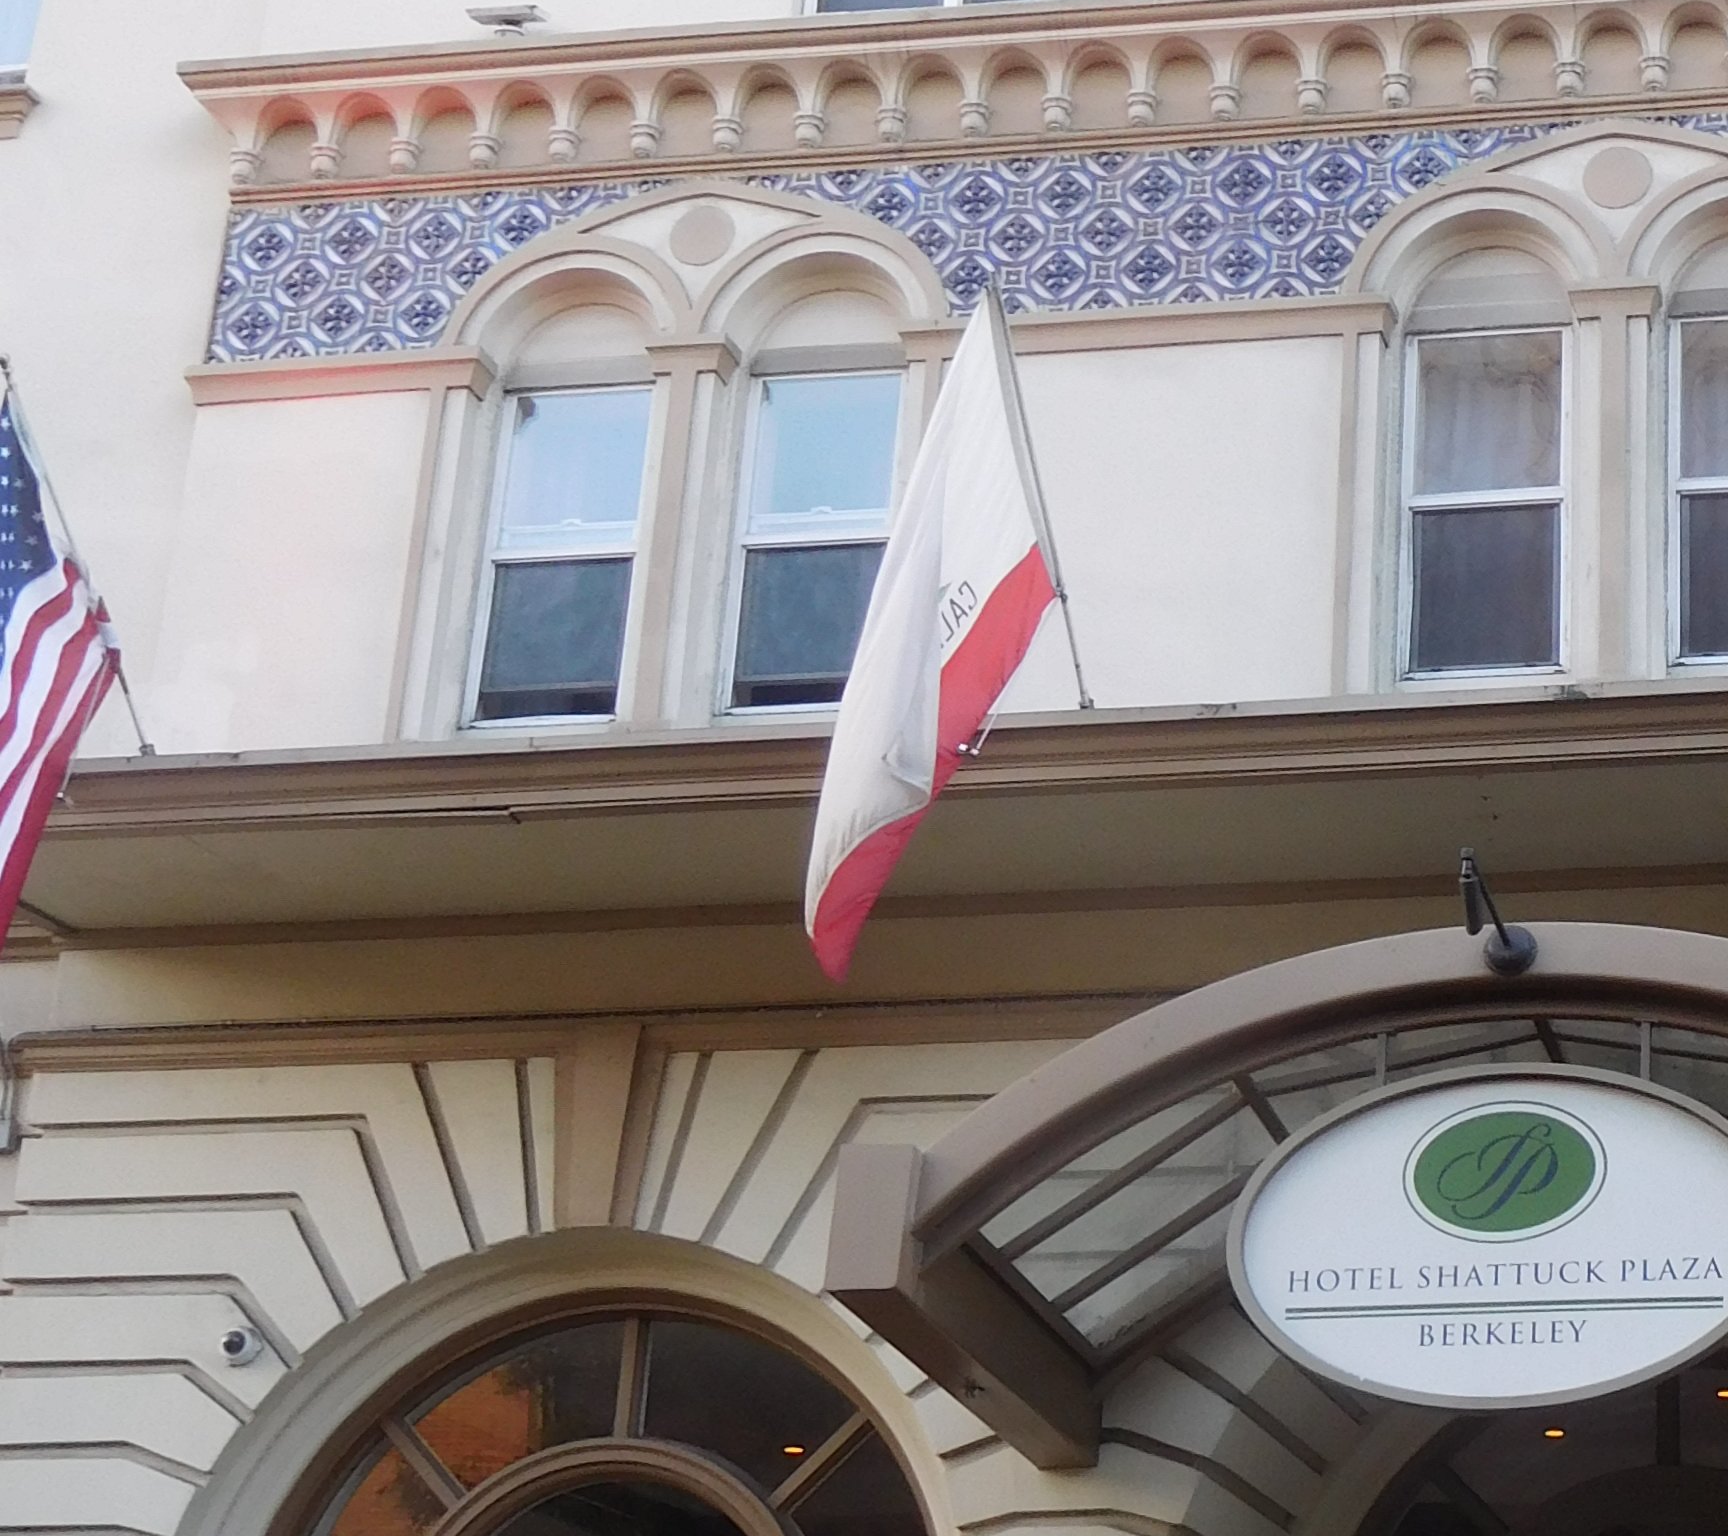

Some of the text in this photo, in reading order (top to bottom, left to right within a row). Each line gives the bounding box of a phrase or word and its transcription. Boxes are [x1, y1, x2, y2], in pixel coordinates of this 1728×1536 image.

[1288, 1257, 1724, 1293] HOTEL SHATTUCK PLAZA
[1418, 1319, 1588, 1347] BERKELEY
